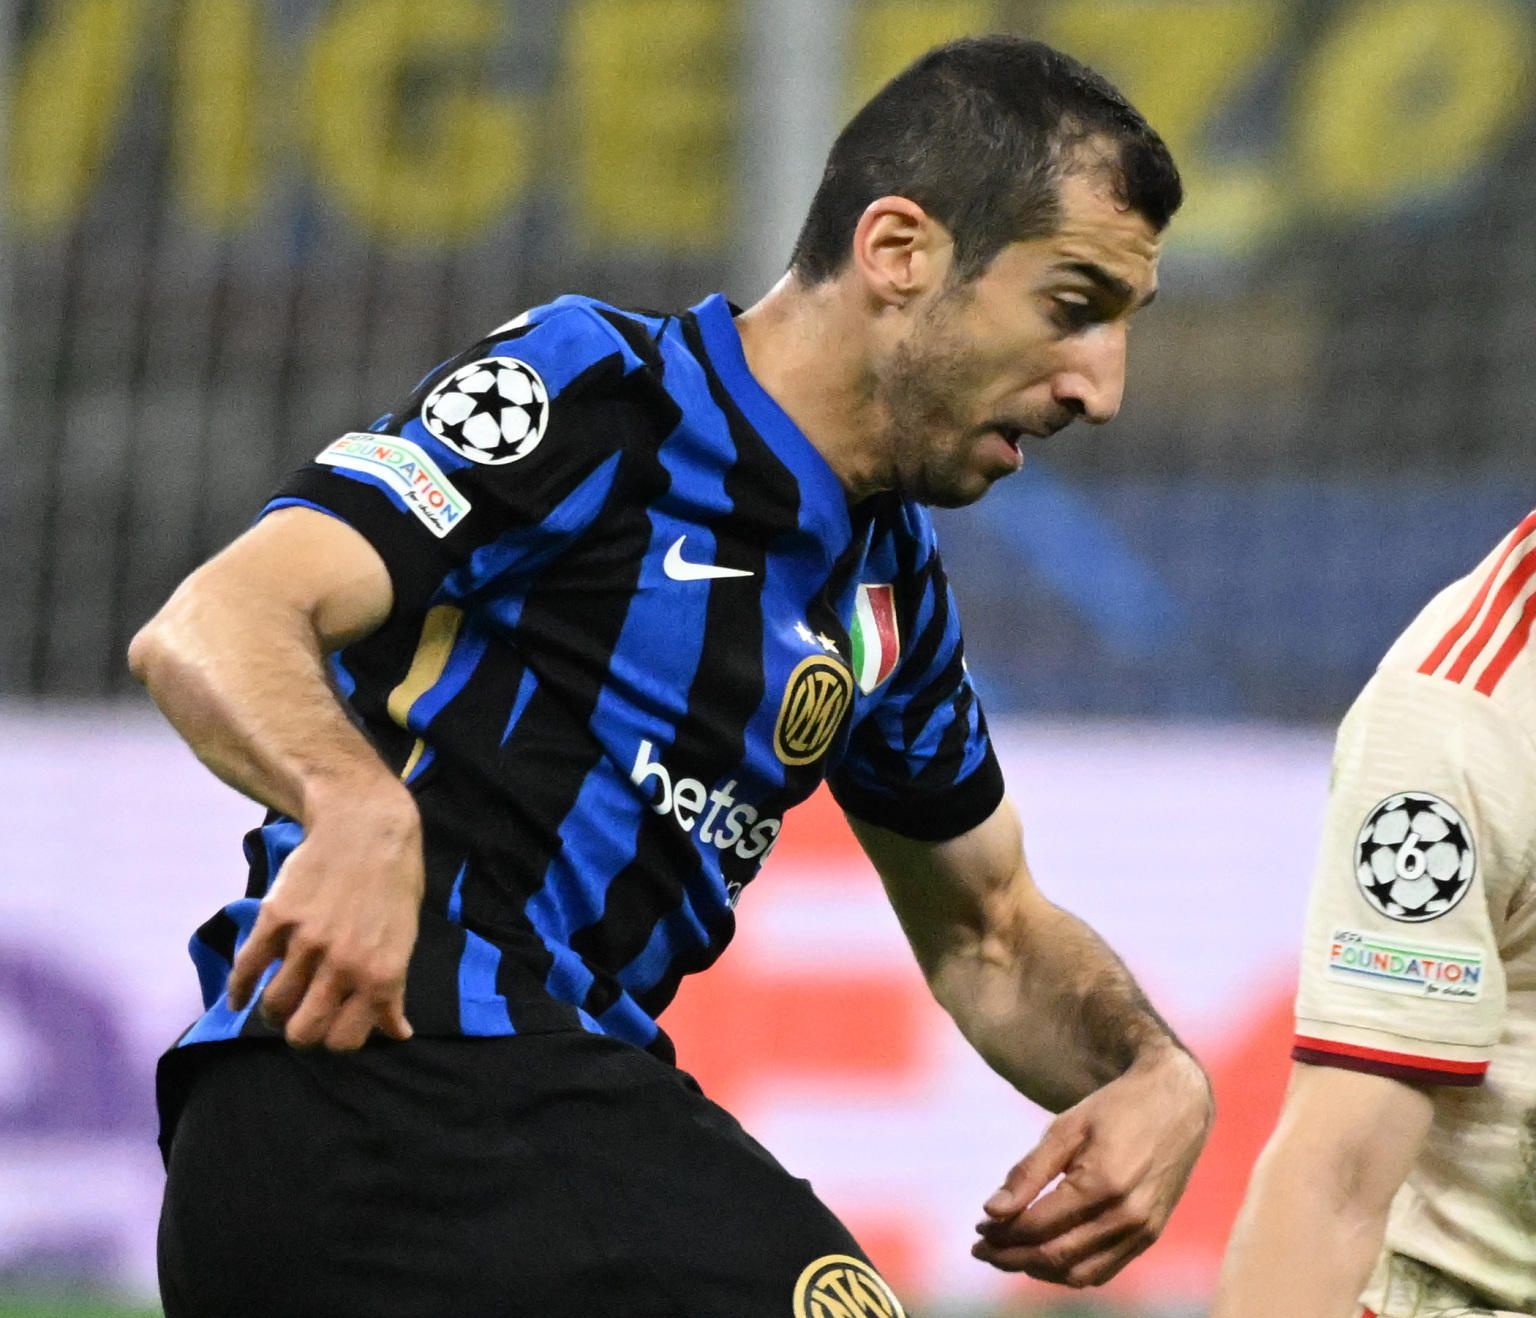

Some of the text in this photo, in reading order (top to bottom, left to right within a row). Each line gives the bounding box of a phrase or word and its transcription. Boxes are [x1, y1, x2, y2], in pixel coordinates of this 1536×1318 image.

[334, 440, 460, 524] FOUNDATION
[630, 739, 781, 866] betss
[1396, 832, 1427, 880] 6
[1330, 943, 1482, 984] FOUNDATION
